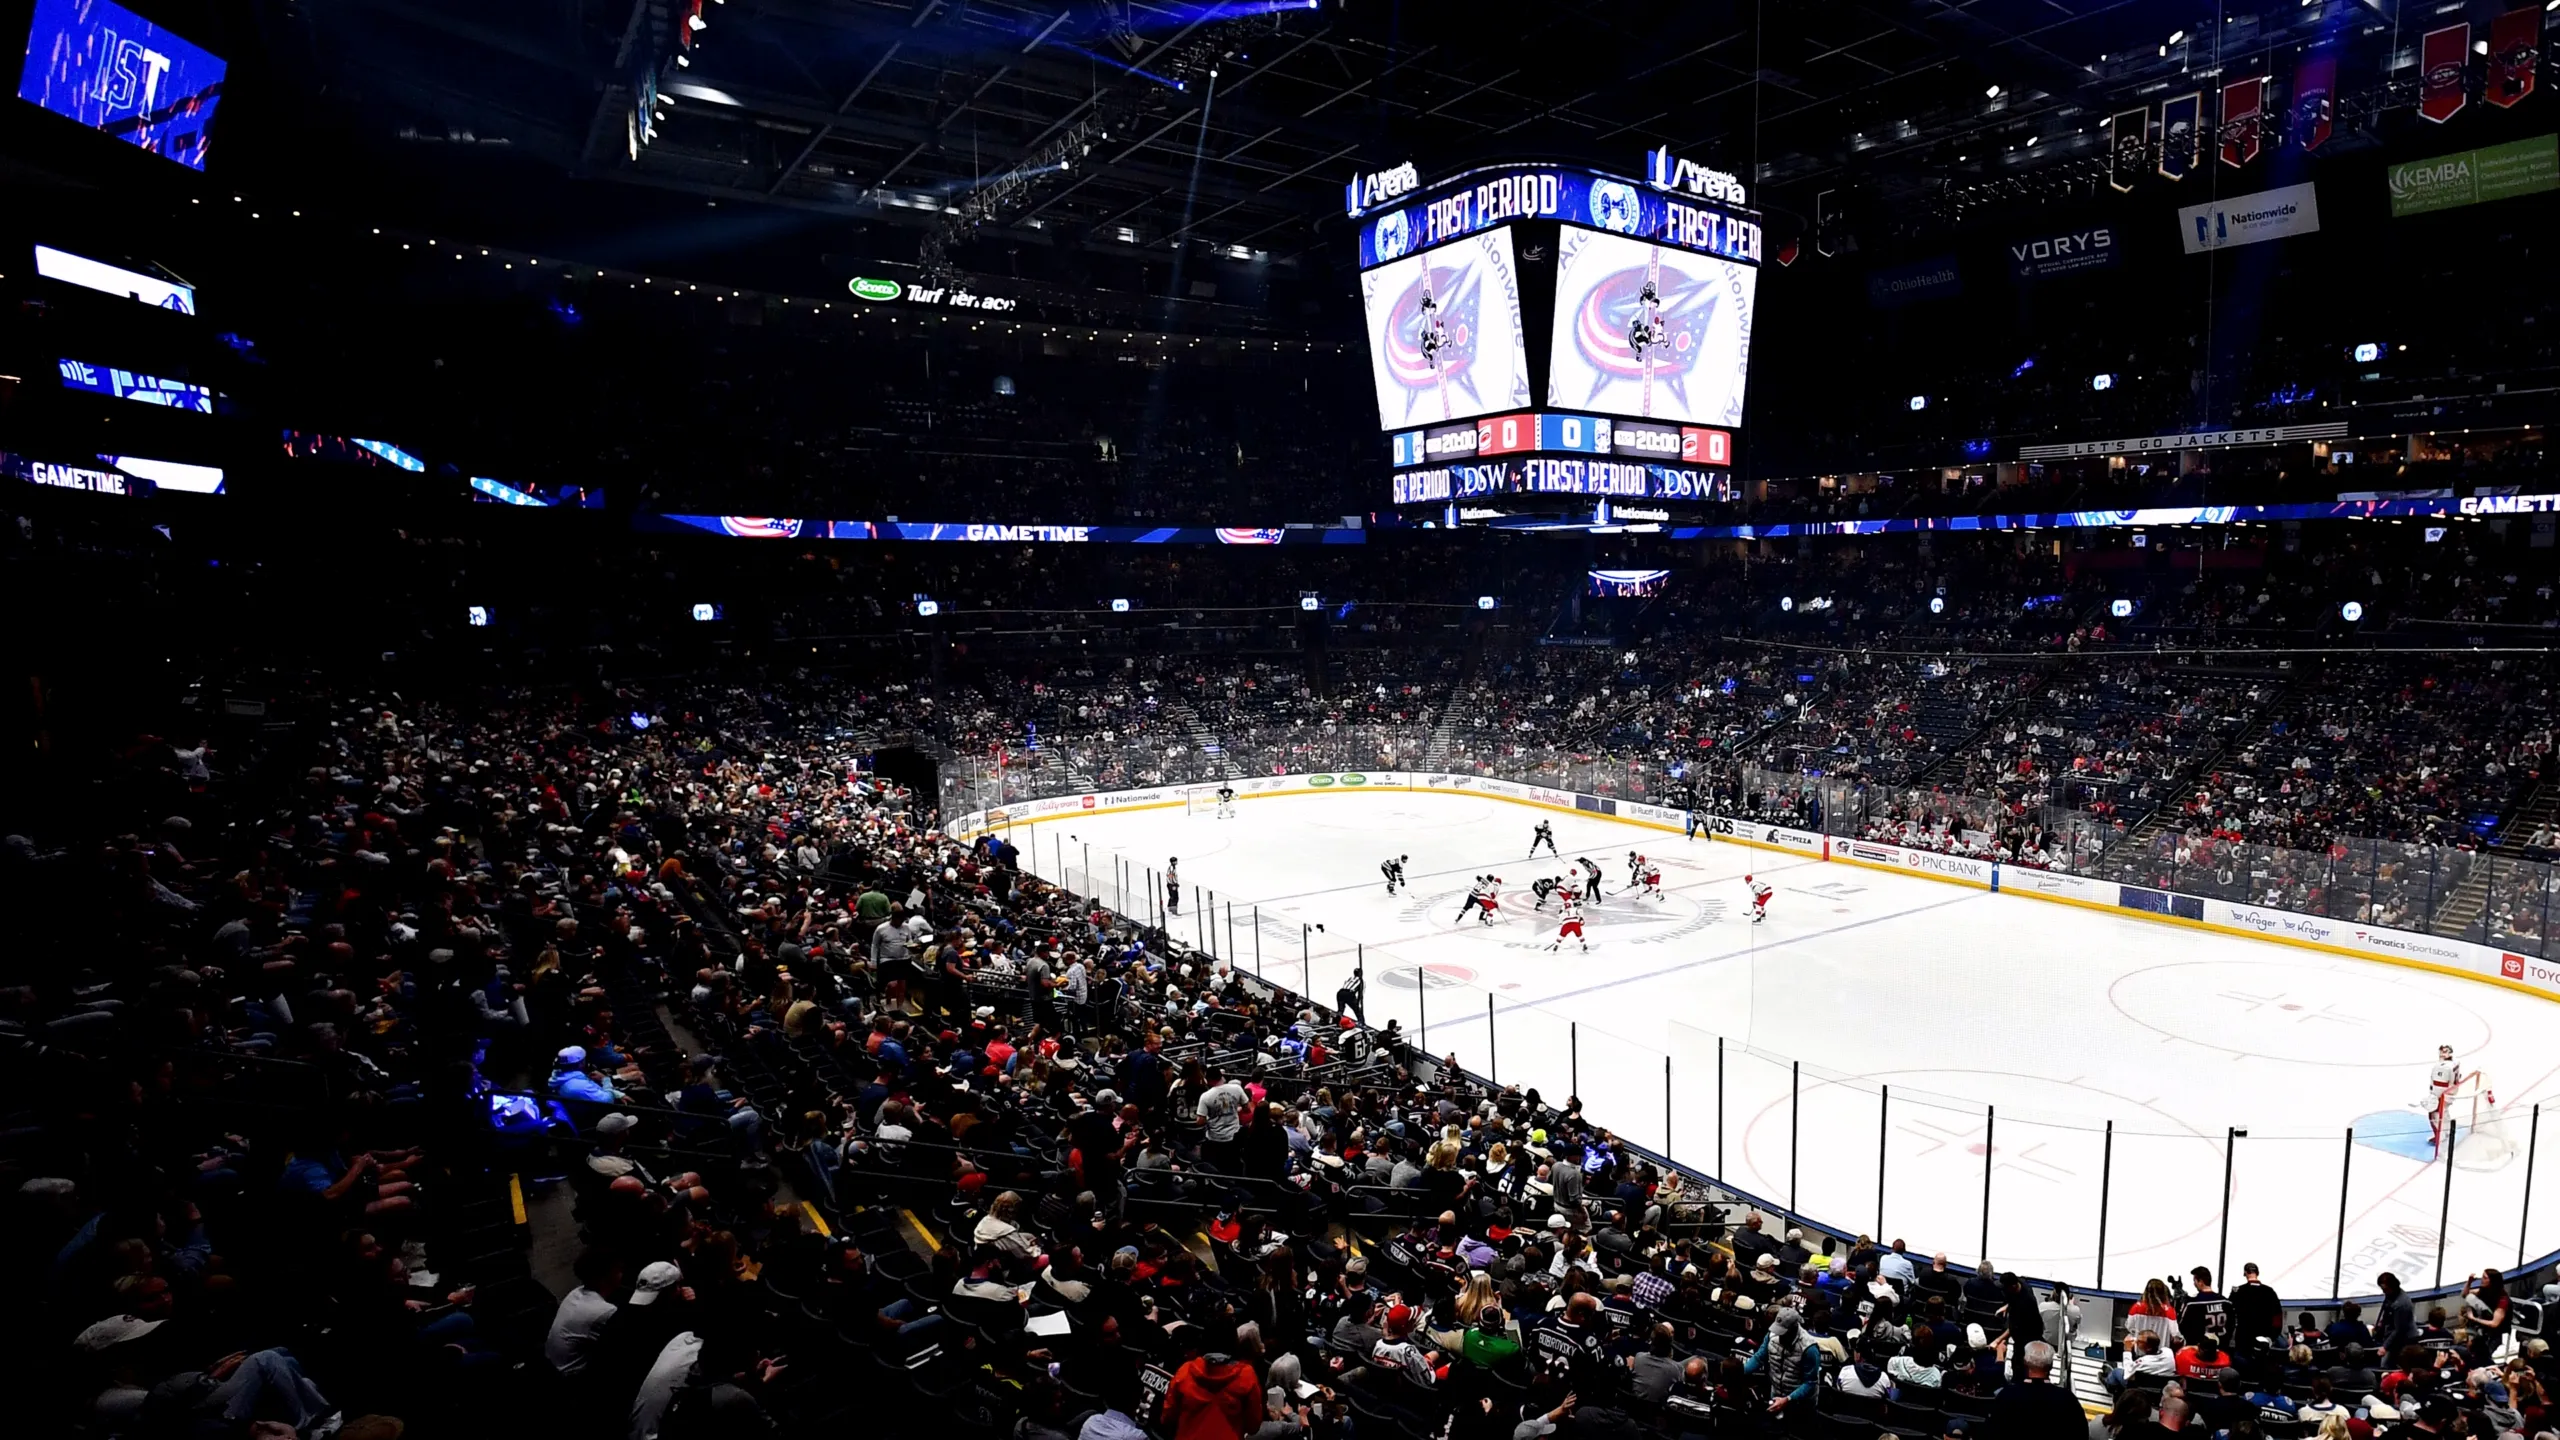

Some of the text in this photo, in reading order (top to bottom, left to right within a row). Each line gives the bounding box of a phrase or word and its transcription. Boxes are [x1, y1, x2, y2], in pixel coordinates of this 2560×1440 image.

[1671, 158, 1745, 204] Arena
[2404, 160, 2470, 188] KEMBA
[2418, 178, 2470, 192] FINANCIAL
[1363, 165, 1419, 207] Arena
[1427, 174, 1557, 242] FIRST PERIOD
[2231, 204, 2297, 225] Nationwide
[1666, 201, 1721, 250] FIRST
[2011, 228, 2111, 262] VORYS
[1890, 268, 1955, 293] OhioHealth
[907, 284, 944, 304] Turf
[1441, 429, 1477, 453] 20:00
[1503, 419, 1517, 449] 0
[1562, 418, 1581, 448] 0
[1635, 430, 1681, 453] 20:00
[2073, 429, 2277, 454] LET'S GO JACKETS
[1709, 433, 1724, 461] 0
[32, 461, 126, 495] GAMETIME
[1408, 468, 1450, 501] PERIOD
[1463, 462, 1508, 494] DSW
[1526, 459, 1716, 498] FIRST PERIOD DSW
[1612, 505, 1669, 521] Nationwide
[967, 524, 1089, 542] GAMETIME
[1310, 776, 1333, 785] Scotts
[1342, 775, 1366, 784] Scotts
[1115, 792, 1161, 804] Nationwide
[1528, 787, 1570, 807] Tim Hortons
[1637, 806, 1654, 816] Ruoff
[1662, 811, 1680, 821] Ruoff
[1710, 817, 1734, 835] ADS
[1792, 836, 1812, 845] PIZZA
[2046, 874, 2065, 882] German
[2066, 878, 2085, 886] Village!
[2245, 912, 2277, 931] Kroger
[2297, 921, 2331, 940] Kroger
[2368, 935, 2461, 960] Fanatics Sportsbook
[1538, 1332, 1578, 1357] BOBROVSKY
